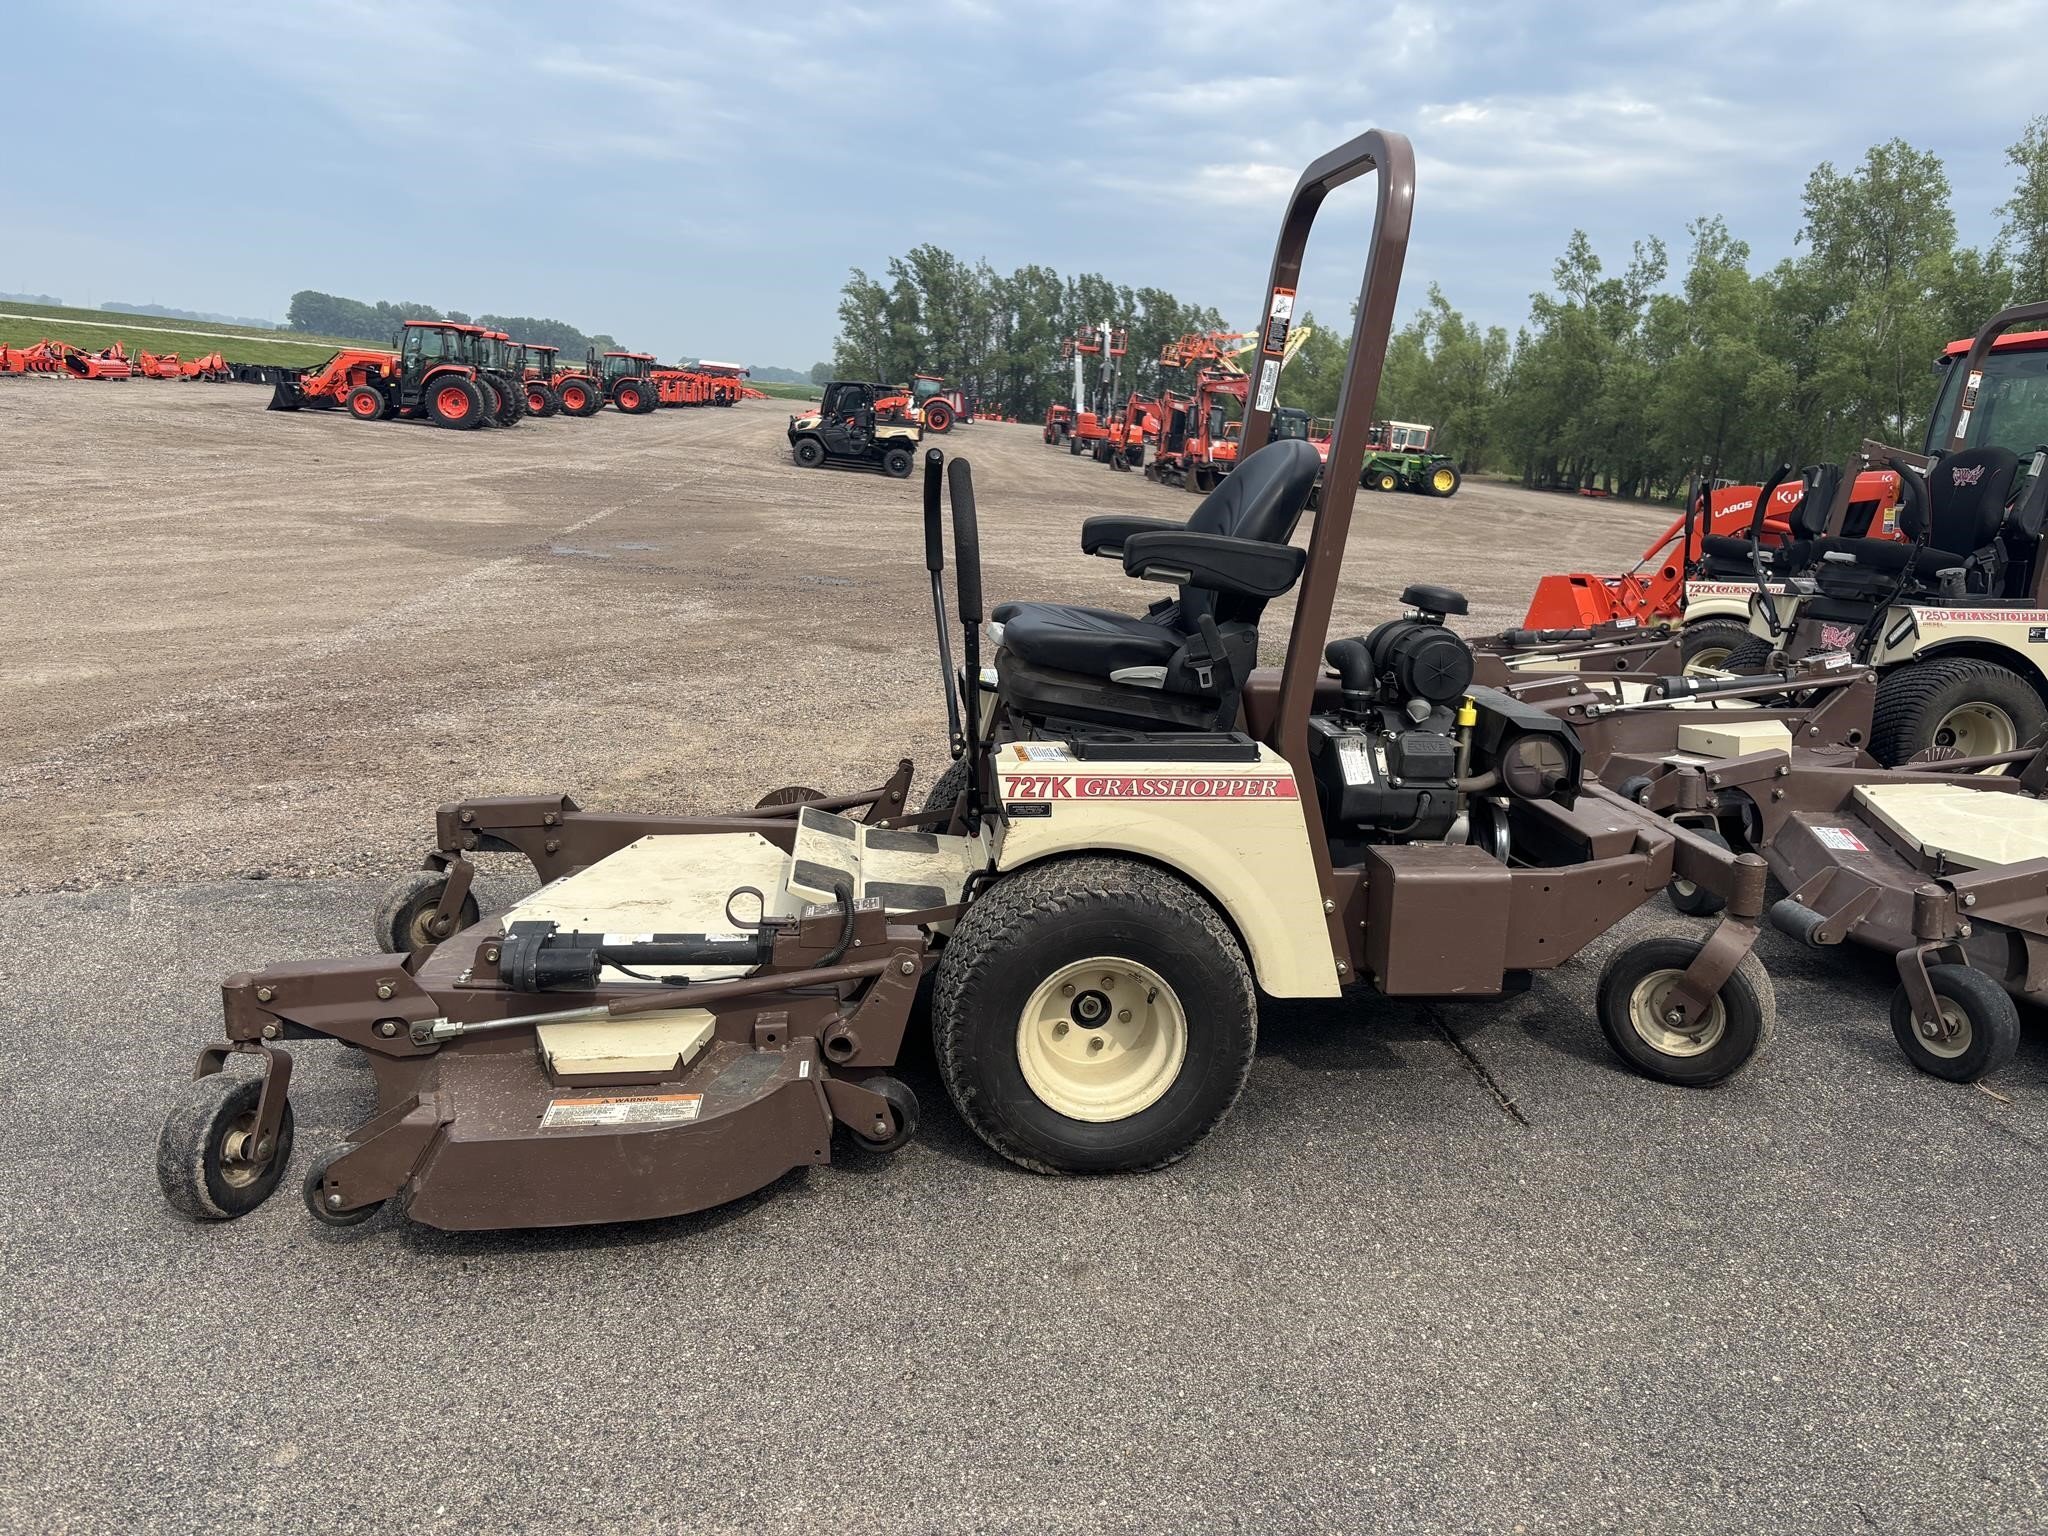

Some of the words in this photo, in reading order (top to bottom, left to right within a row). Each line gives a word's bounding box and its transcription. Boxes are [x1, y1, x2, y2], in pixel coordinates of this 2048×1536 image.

[1689, 584, 1715, 594] 727K
[1917, 610, 1949, 621] 725D
[1005, 776, 1072, 798] 727K
[1083, 778, 1279, 797] GRASSHOPPER
[615, 1096, 659, 1104] WARNING
